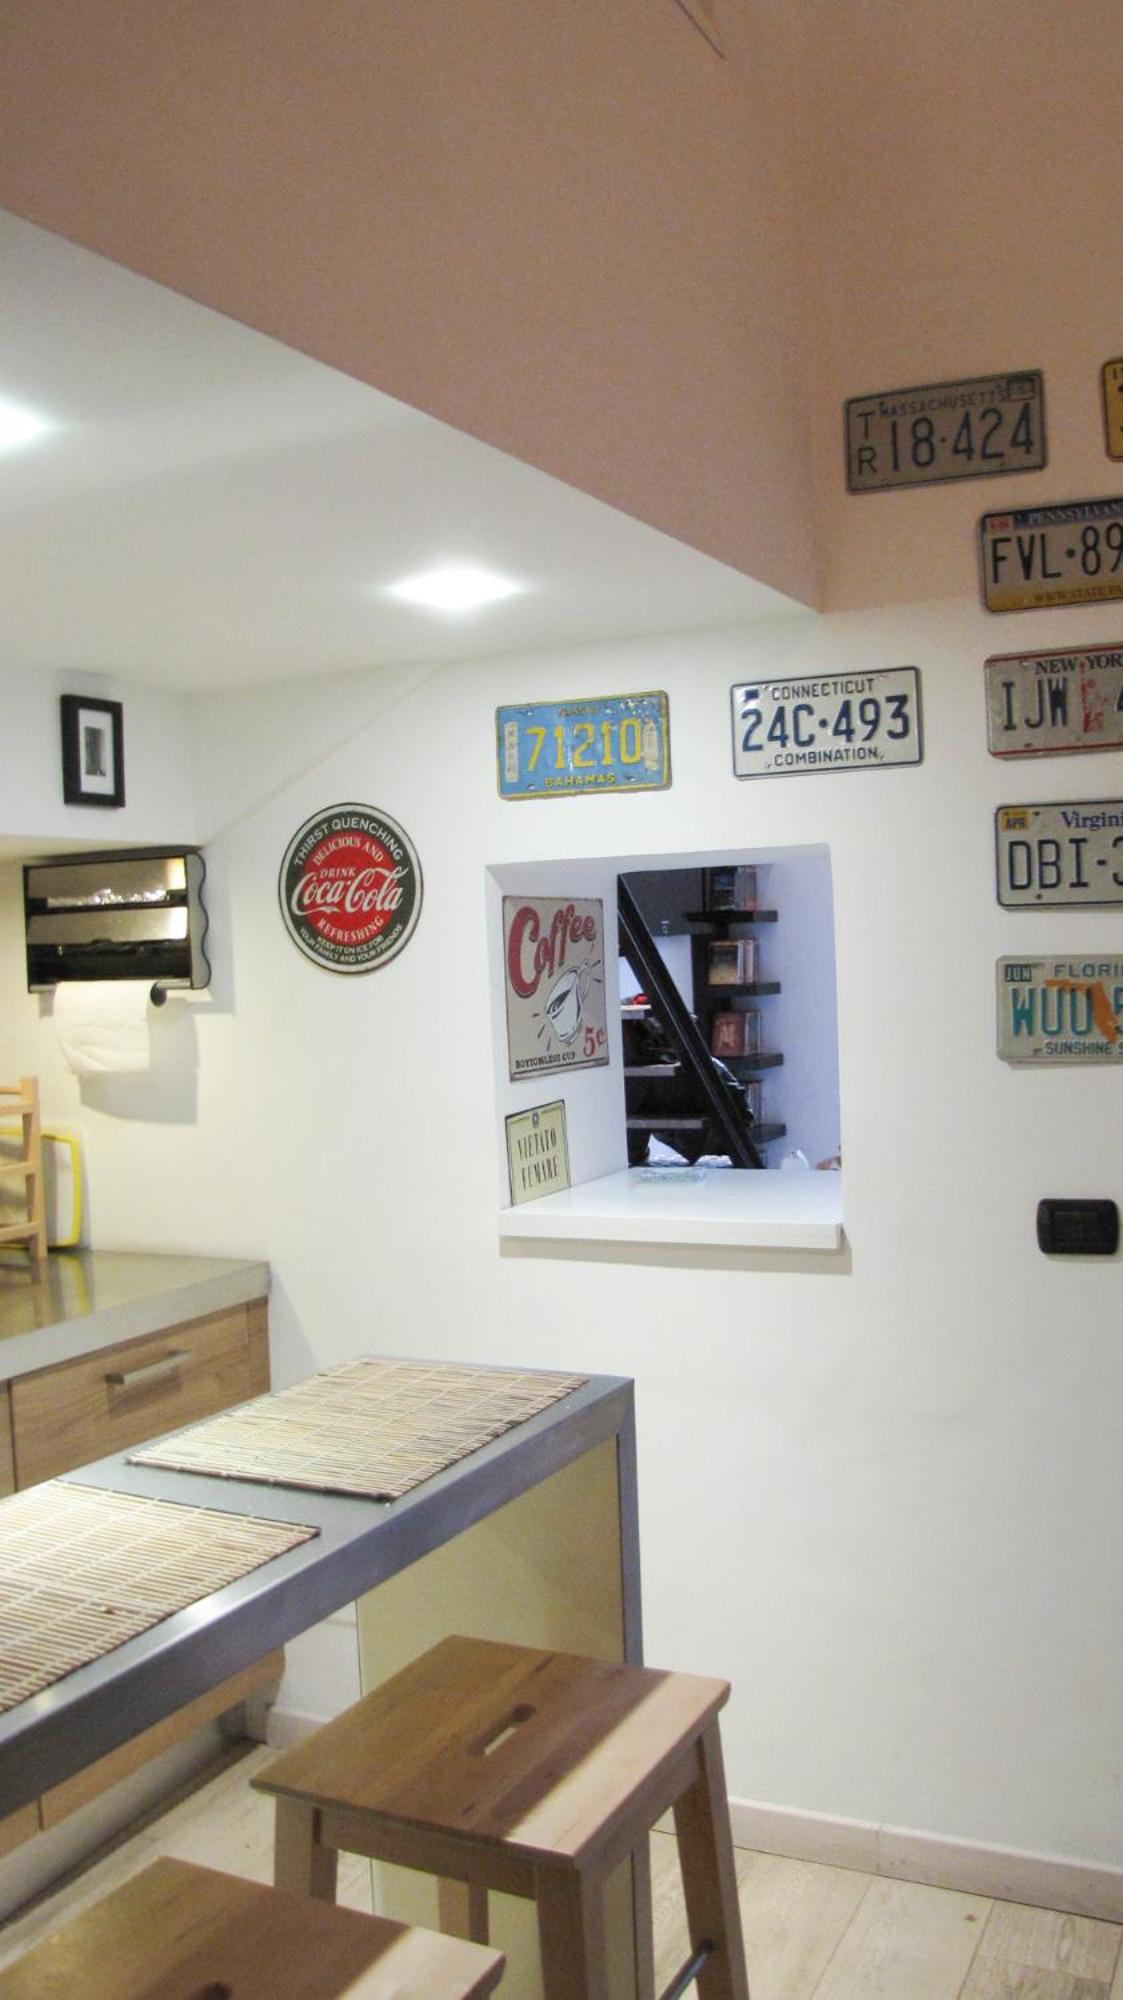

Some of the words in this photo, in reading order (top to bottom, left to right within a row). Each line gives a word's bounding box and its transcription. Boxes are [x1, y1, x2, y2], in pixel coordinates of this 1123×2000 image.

[879, 389, 1006, 417] MASSACHUSETTS
[1035, 657, 1078, 675] NEW
[771, 678, 875, 701] CONNECTICUT
[1002, 677, 1067, 731] IJW
[526, 718, 641, 772] 71210
[774, 746, 878, 766] COMBINATION
[544, 773, 616, 787] BAHAMAS
[295, 824, 329, 867] THIRST
[332, 816, 403, 861] QUENCHING
[312, 835, 361, 865] DELICIOUS
[363, 842, 384, 862] AND
[320, 866, 357, 878] DRINK
[318, 916, 384, 942] REFRESHING
[508, 904, 597, 999] Coffee
[1006, 965, 1031, 981] JUN
[515, 1054, 560, 1069] BOTTOMLESS
[562, 1051, 576, 1061] CUP
[1045, 1042, 1112, 1055] SUNSHINE
